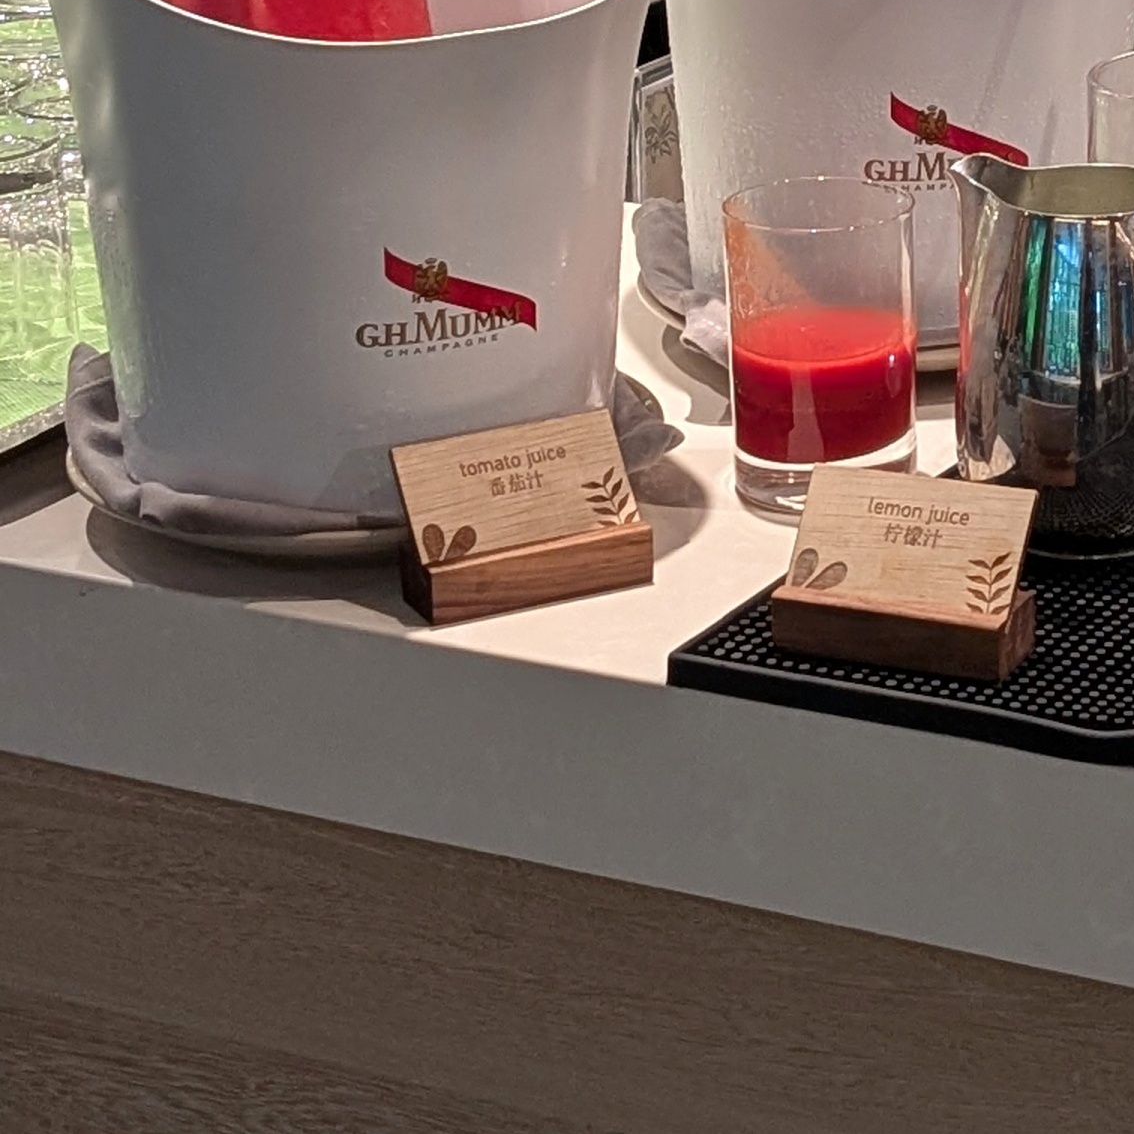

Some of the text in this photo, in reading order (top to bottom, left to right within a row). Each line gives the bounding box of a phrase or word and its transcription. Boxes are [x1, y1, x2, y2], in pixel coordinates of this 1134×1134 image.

[384, 333, 498, 358] CHAMPAGNE
[459, 446, 566, 477] tomato juice
[867, 497, 970, 526] lemon juice
